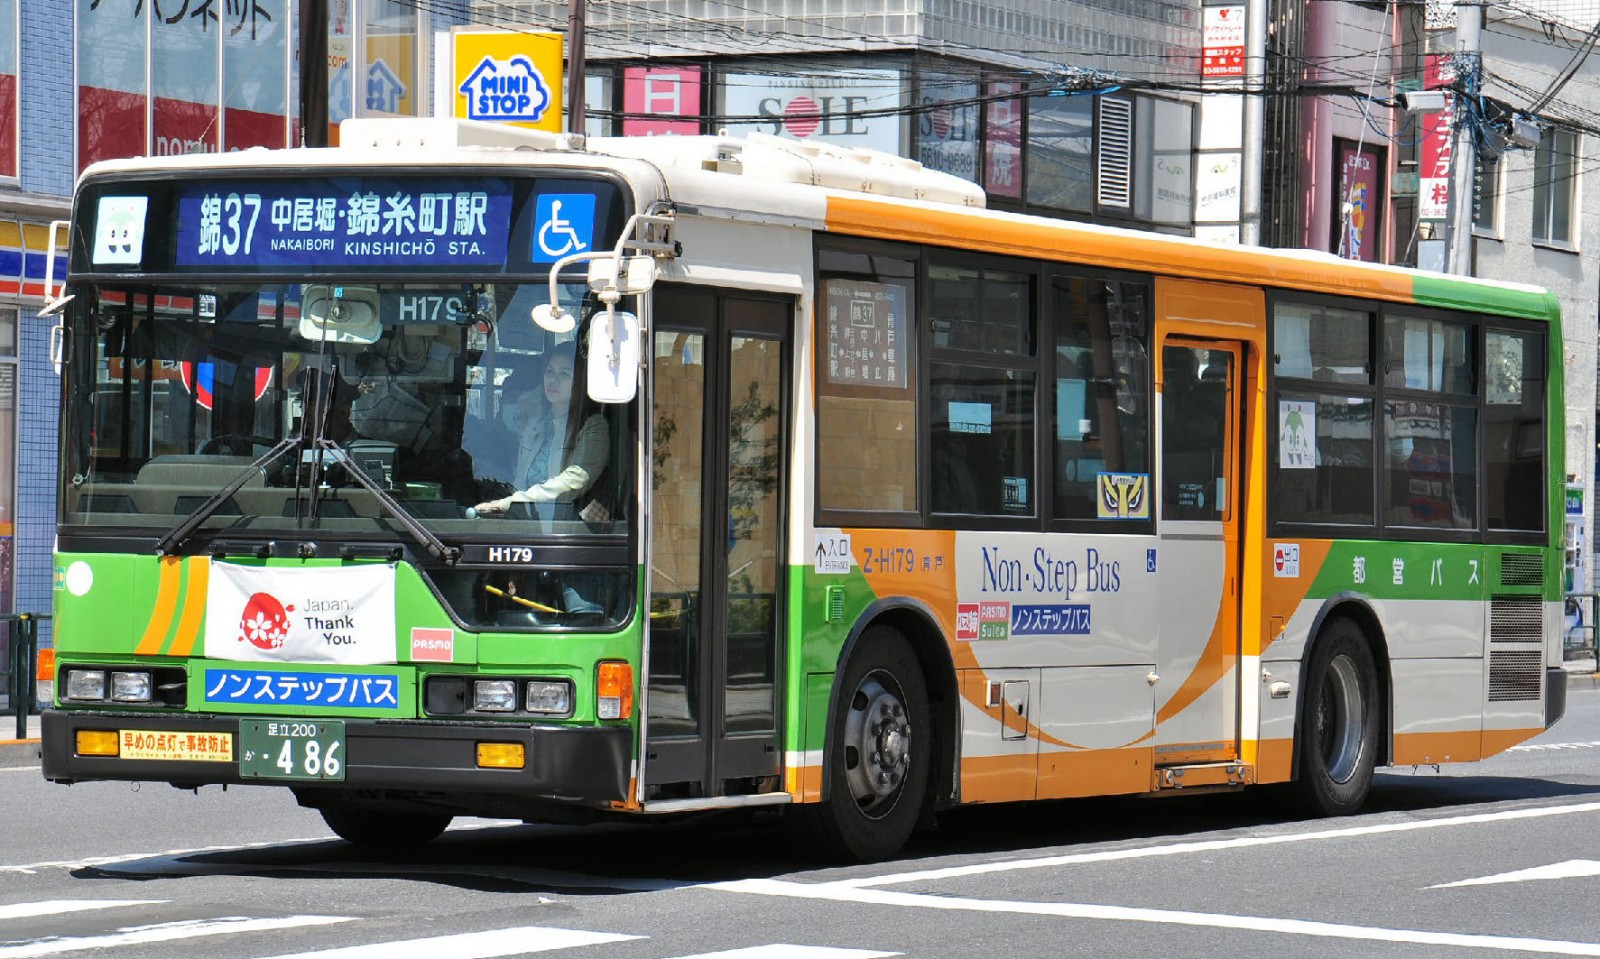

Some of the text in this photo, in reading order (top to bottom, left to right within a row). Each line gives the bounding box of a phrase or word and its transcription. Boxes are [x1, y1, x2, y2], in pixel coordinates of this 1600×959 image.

[481, 76, 528, 94] MINI
[479, 95, 530, 114] STOP
[757, 96, 868, 137] SOLE
[199, 193, 262, 255] 錦37
[271, 238, 334, 251] NAKAIBORI
[448, 241, 486, 255] STA.
[400, 296, 463, 321] H179
[489, 547, 532, 562] H179
[828, 539, 848, 556] 入口
[864, 548, 914, 573] Z-H179
[1086, 548, 1120, 592] Bus
[303, 598, 354, 612] Japan.
[981, 605, 1007, 619] PASMO
[304, 616, 354, 630] Thank
[1012, 607, 1091, 631] ノンステップバス
[323, 632, 356, 645] You.
[981, 624, 1005, 638] Suica
[413, 640, 451, 650] PASMO
[207, 674, 397, 703] ノンステップバス
[124, 732, 230, 754] 早めの点灯で事故防止
